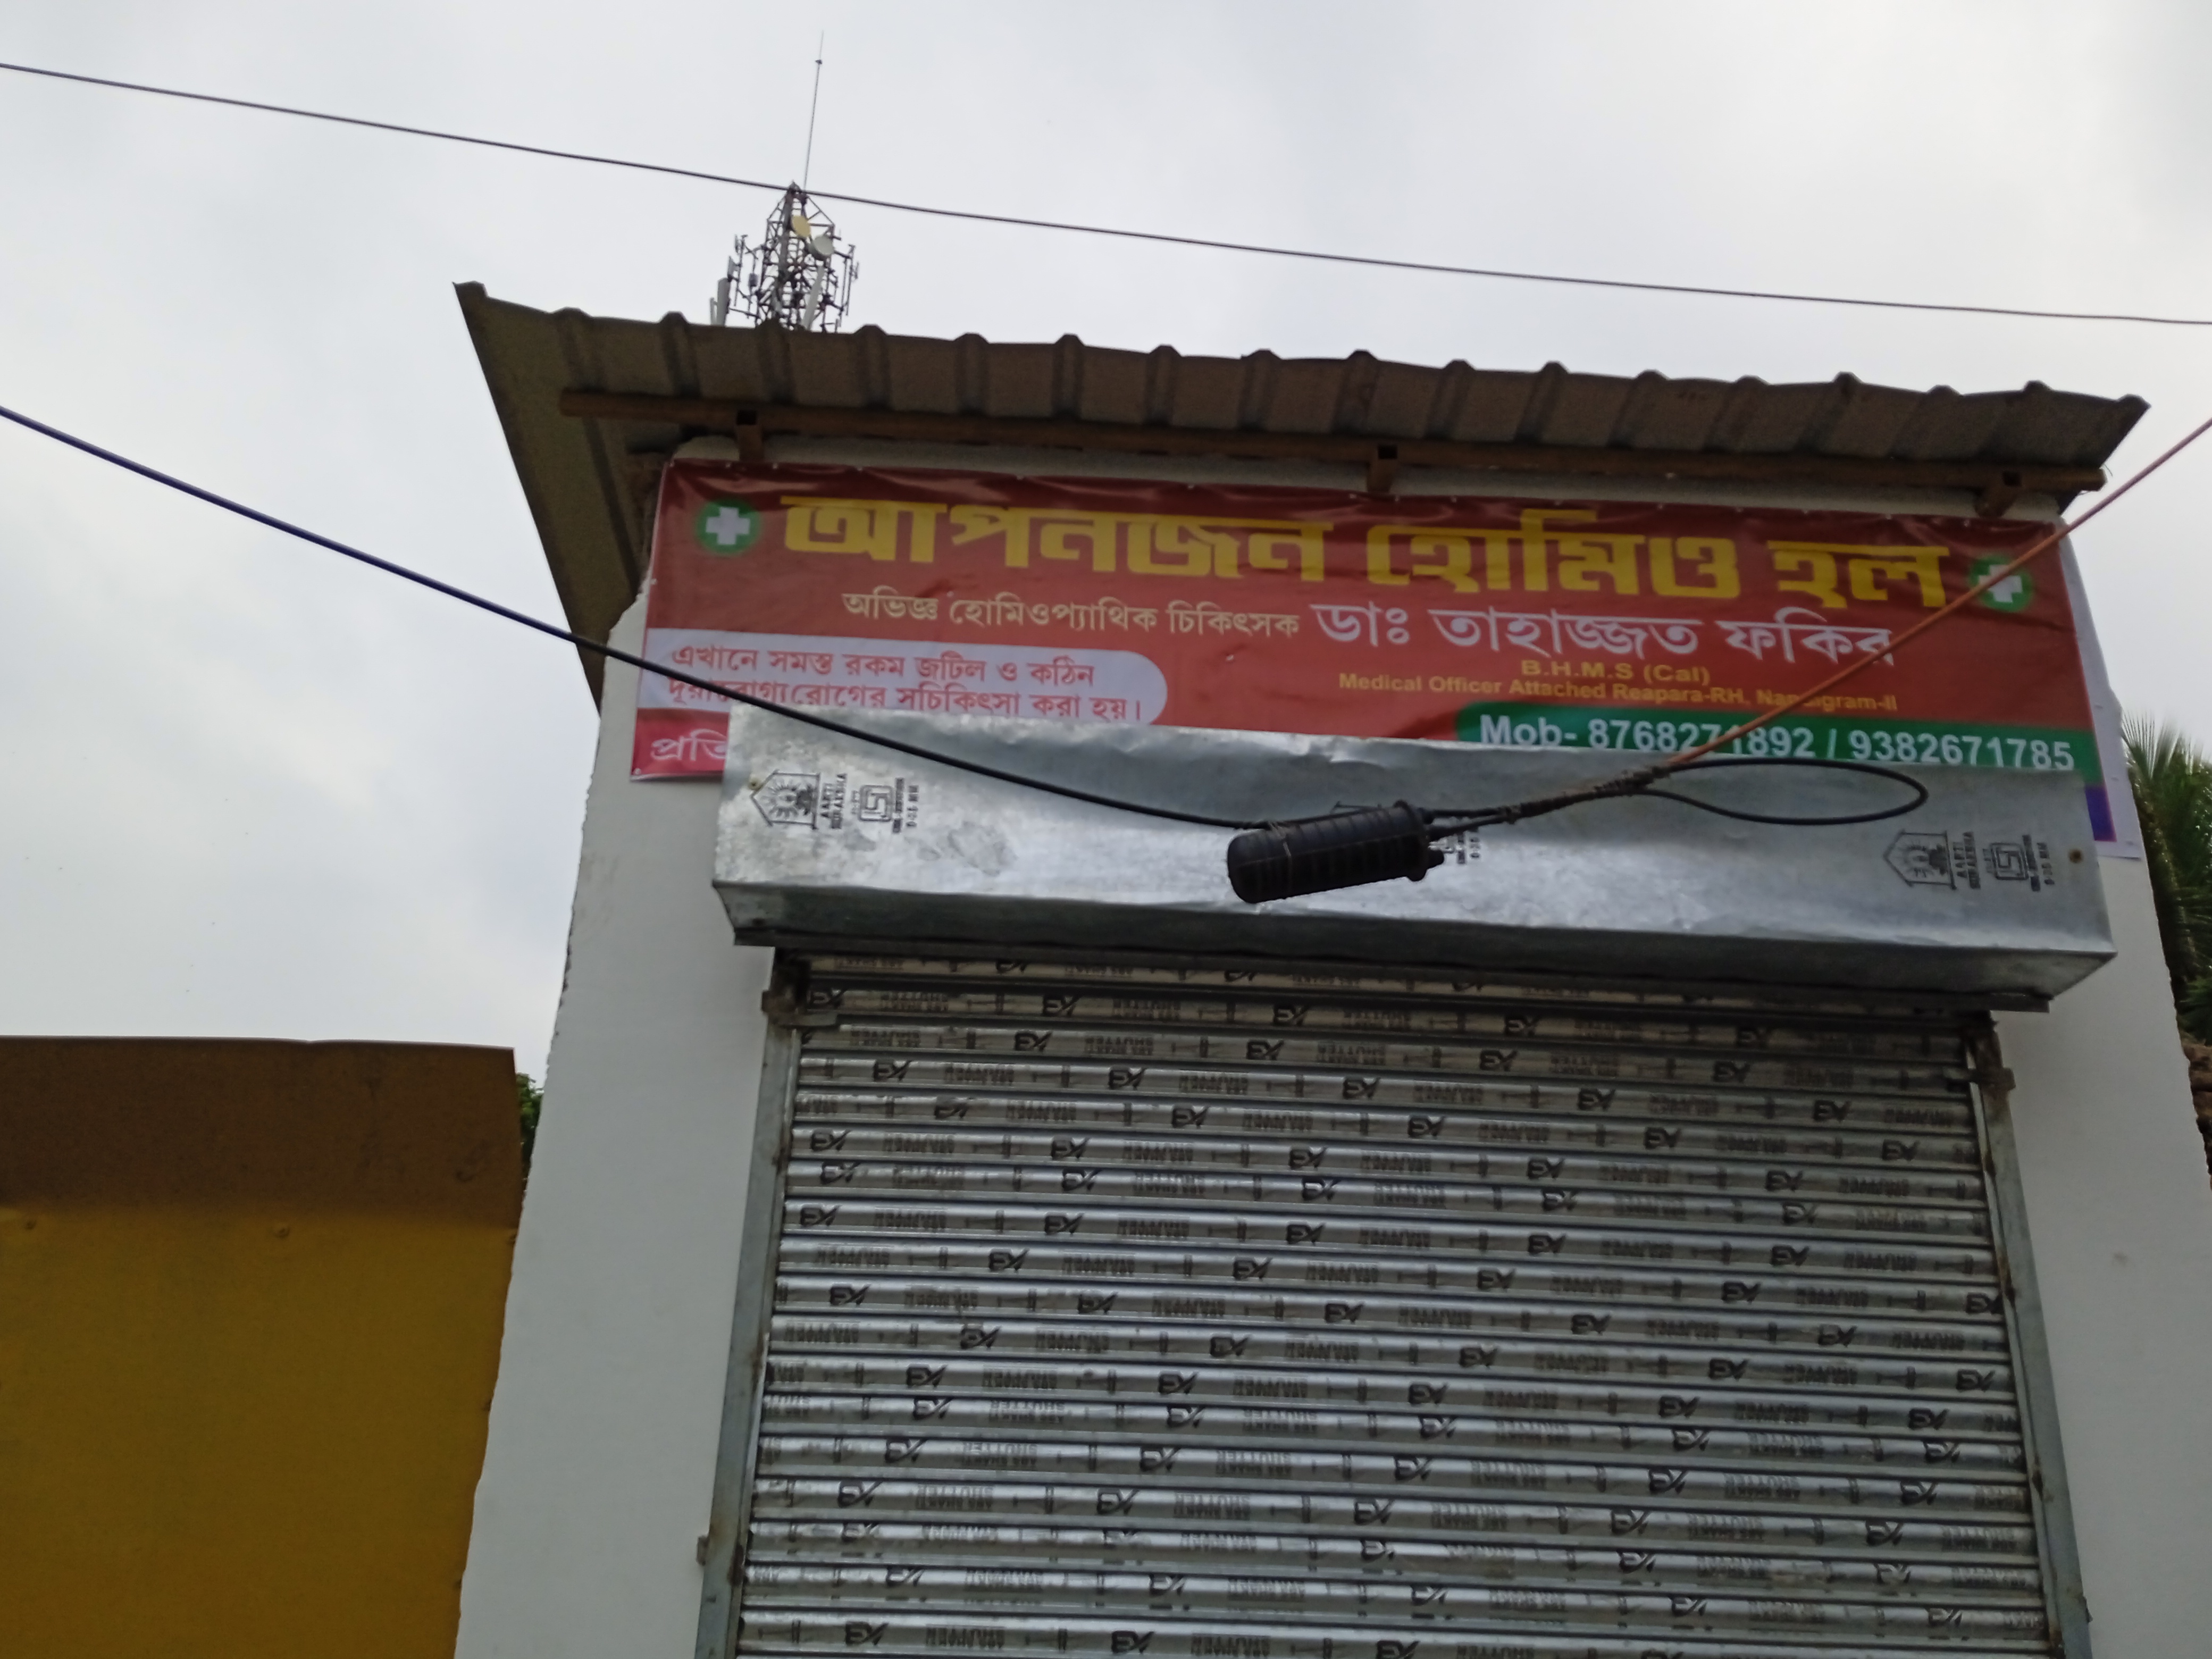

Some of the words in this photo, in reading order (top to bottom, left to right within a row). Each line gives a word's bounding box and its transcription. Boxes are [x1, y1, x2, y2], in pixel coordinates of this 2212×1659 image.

[780, 496, 1334, 582] আপনজন
[1366, 509, 1741, 599] হোমিও
[1767, 540, 1950, 608] হল
[841, 585, 939, 621] অভিজ্ঞ
[950, 591, 1159, 632] হোমিওপ্যাথিক
[1166, 601, 1301, 638] চিকিৎসক
[1715, 607, 1895, 666] ফকির
[672, 645, 759, 672] এখানে
[767, 650, 834, 675] সমস্ত
[842, 653, 905, 676] রকম
[914, 649, 986, 683] জটিল
[998, 661, 1018, 682] ও
[1027, 655, 1094, 687] কঠিন
[1339, 672, 1422, 691] Medical
[1429, 675, 1502, 694] Officer
[1509, 678, 1606, 699] Attached
[1521, 659, 1633, 679] B.H.M.S
[1644, 664, 1711, 686] (Cal)
[1029, 693, 1082, 720] করা
[1848, 730, 2075, 771] 9382671785
